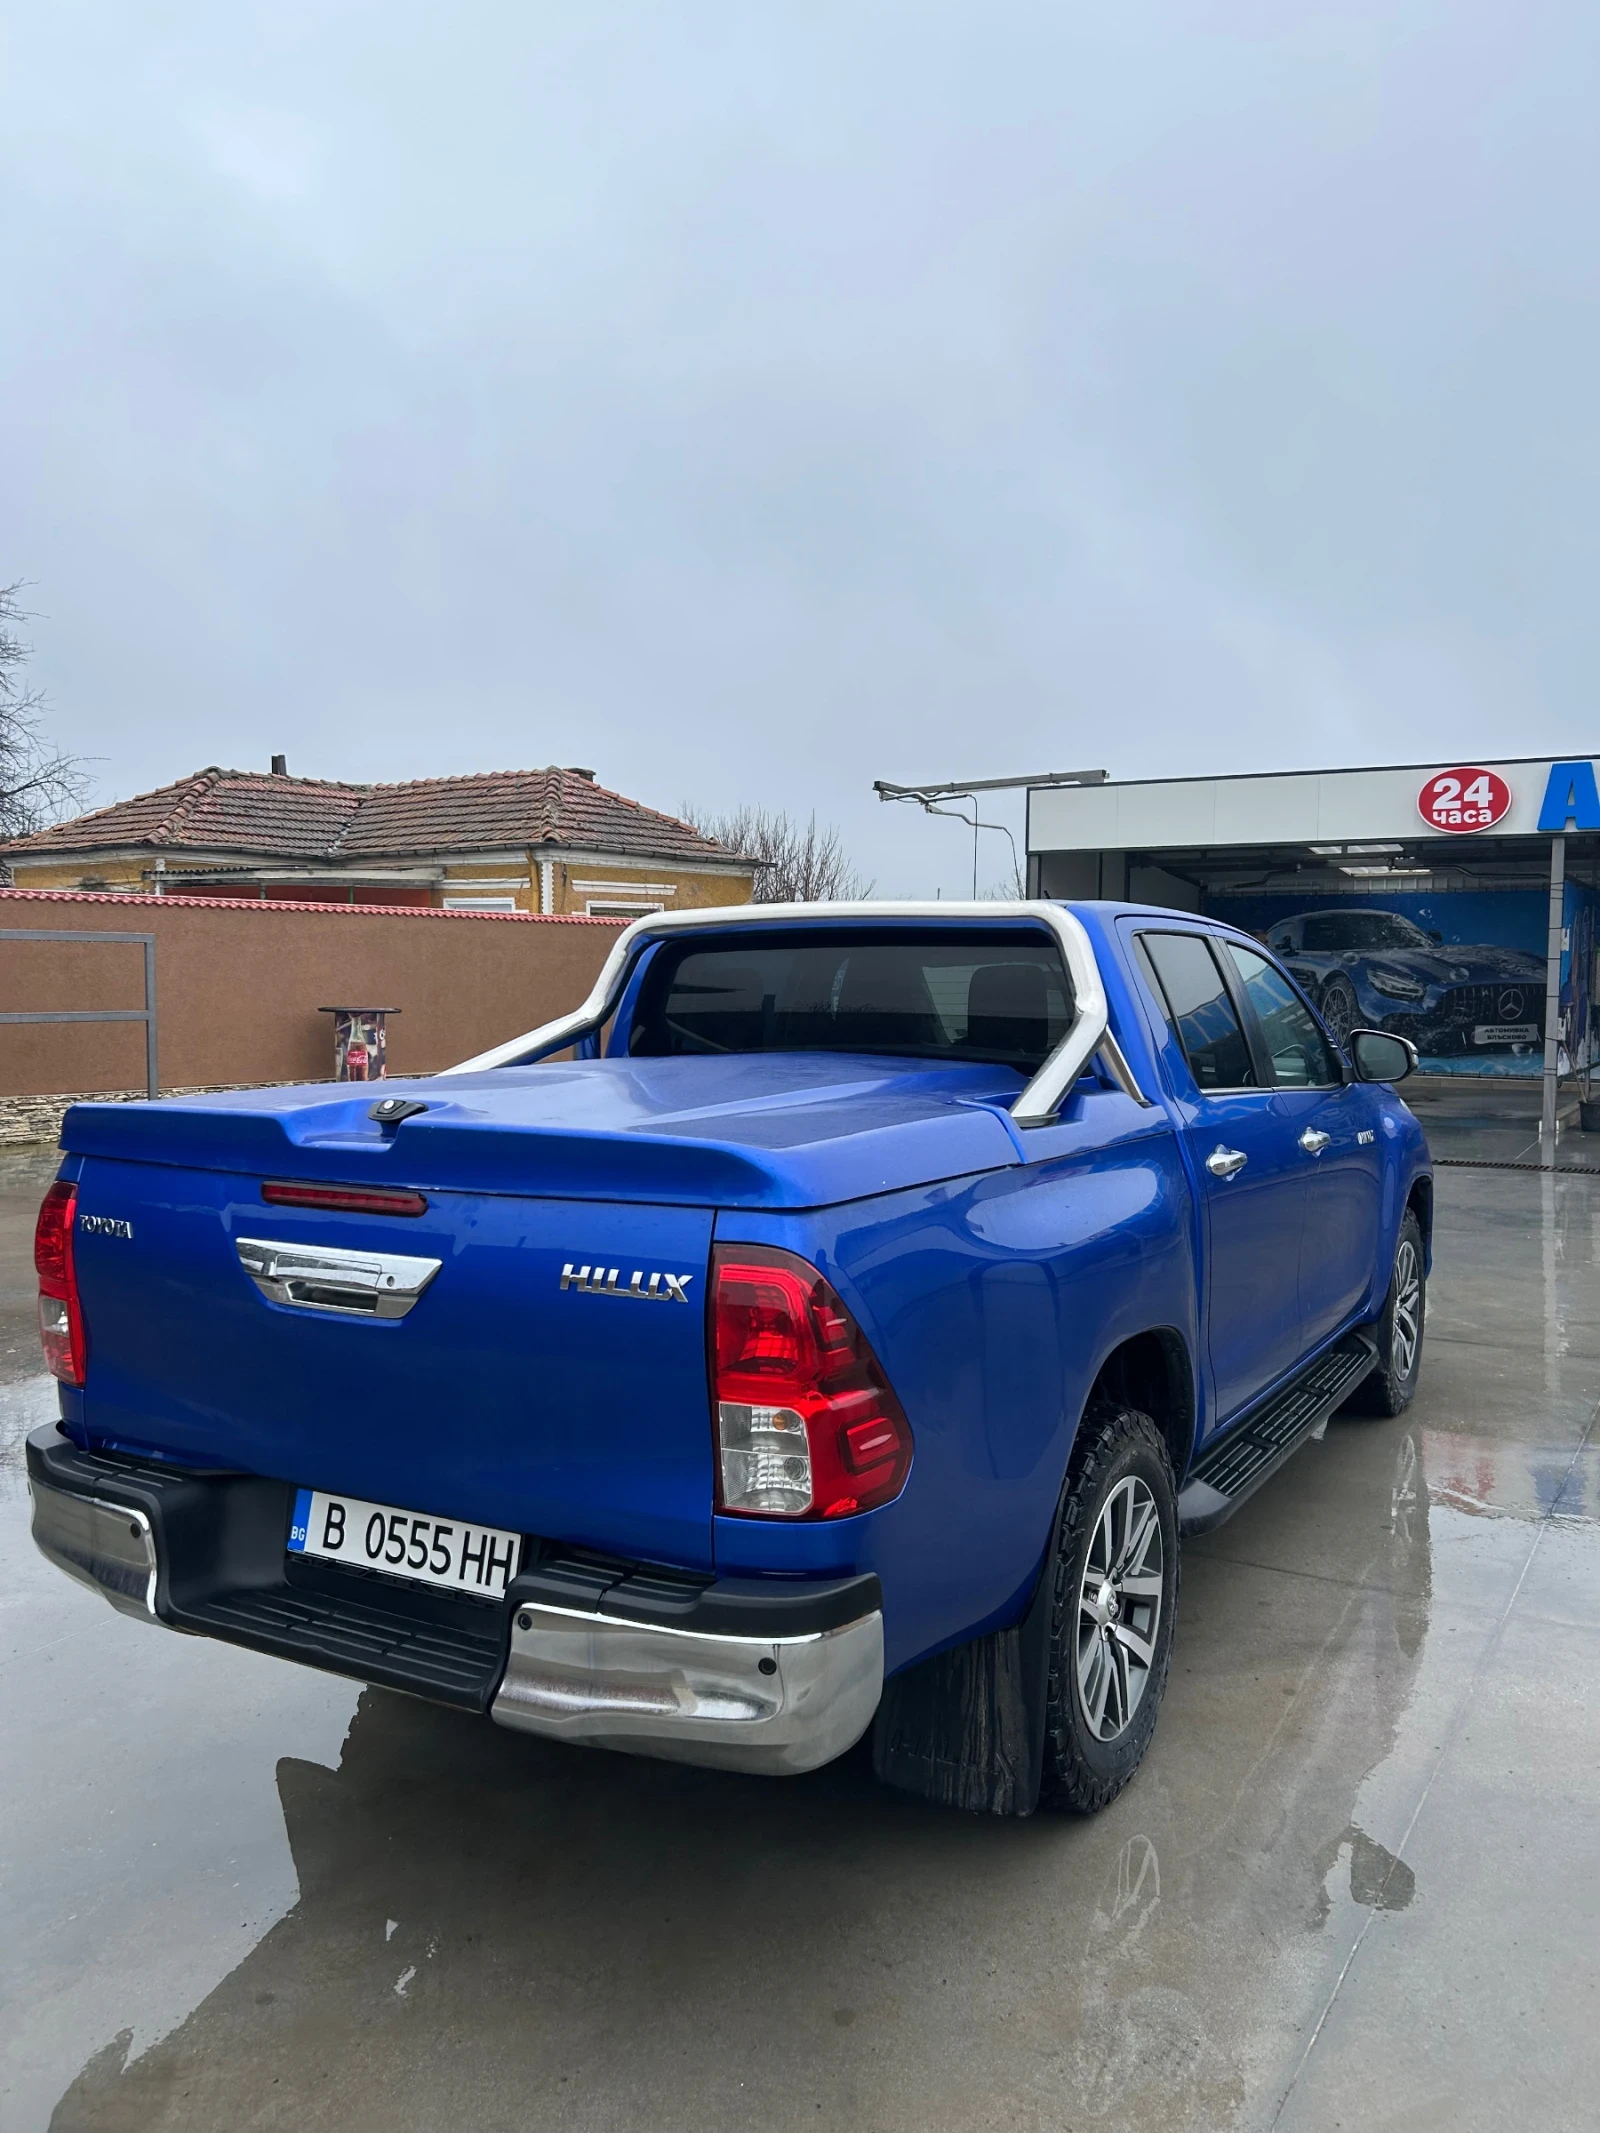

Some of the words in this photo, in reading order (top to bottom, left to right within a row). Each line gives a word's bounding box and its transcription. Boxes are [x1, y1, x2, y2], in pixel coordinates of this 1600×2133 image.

[1432, 776, 1493, 810] 24
[1432, 808, 1492, 824] часа
[79, 1214, 133, 1239] TOYOTA
[560, 1263, 694, 1303] HILUX
[290, 1525, 306, 1542] BG
[322, 1501, 347, 1550] B
